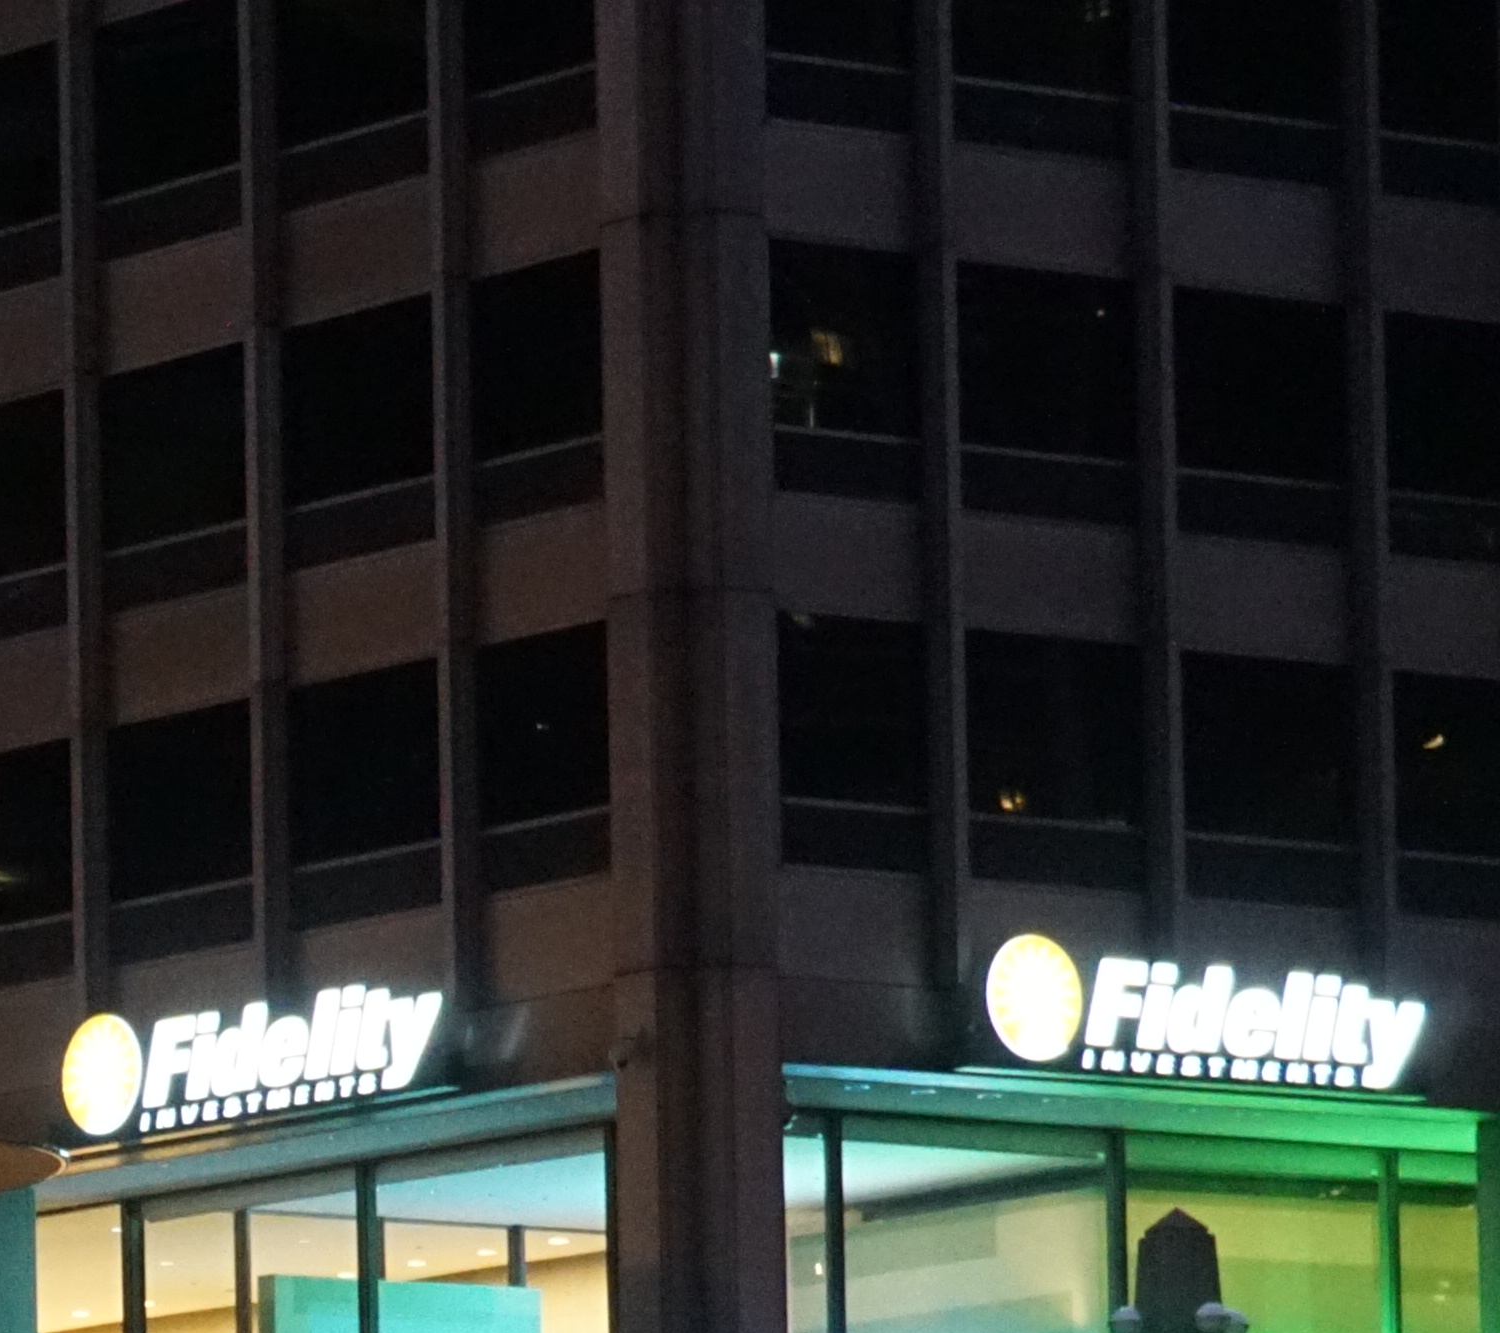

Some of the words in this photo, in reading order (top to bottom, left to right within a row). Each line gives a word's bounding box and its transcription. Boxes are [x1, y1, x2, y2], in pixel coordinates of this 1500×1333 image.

[141, 983, 443, 1109] Fidelity
[1081, 1047, 1357, 1088] INVESTMENTS
[1084, 956, 1427, 1090] Fidelity
[138, 1072, 378, 1133] INVESTMENTS
